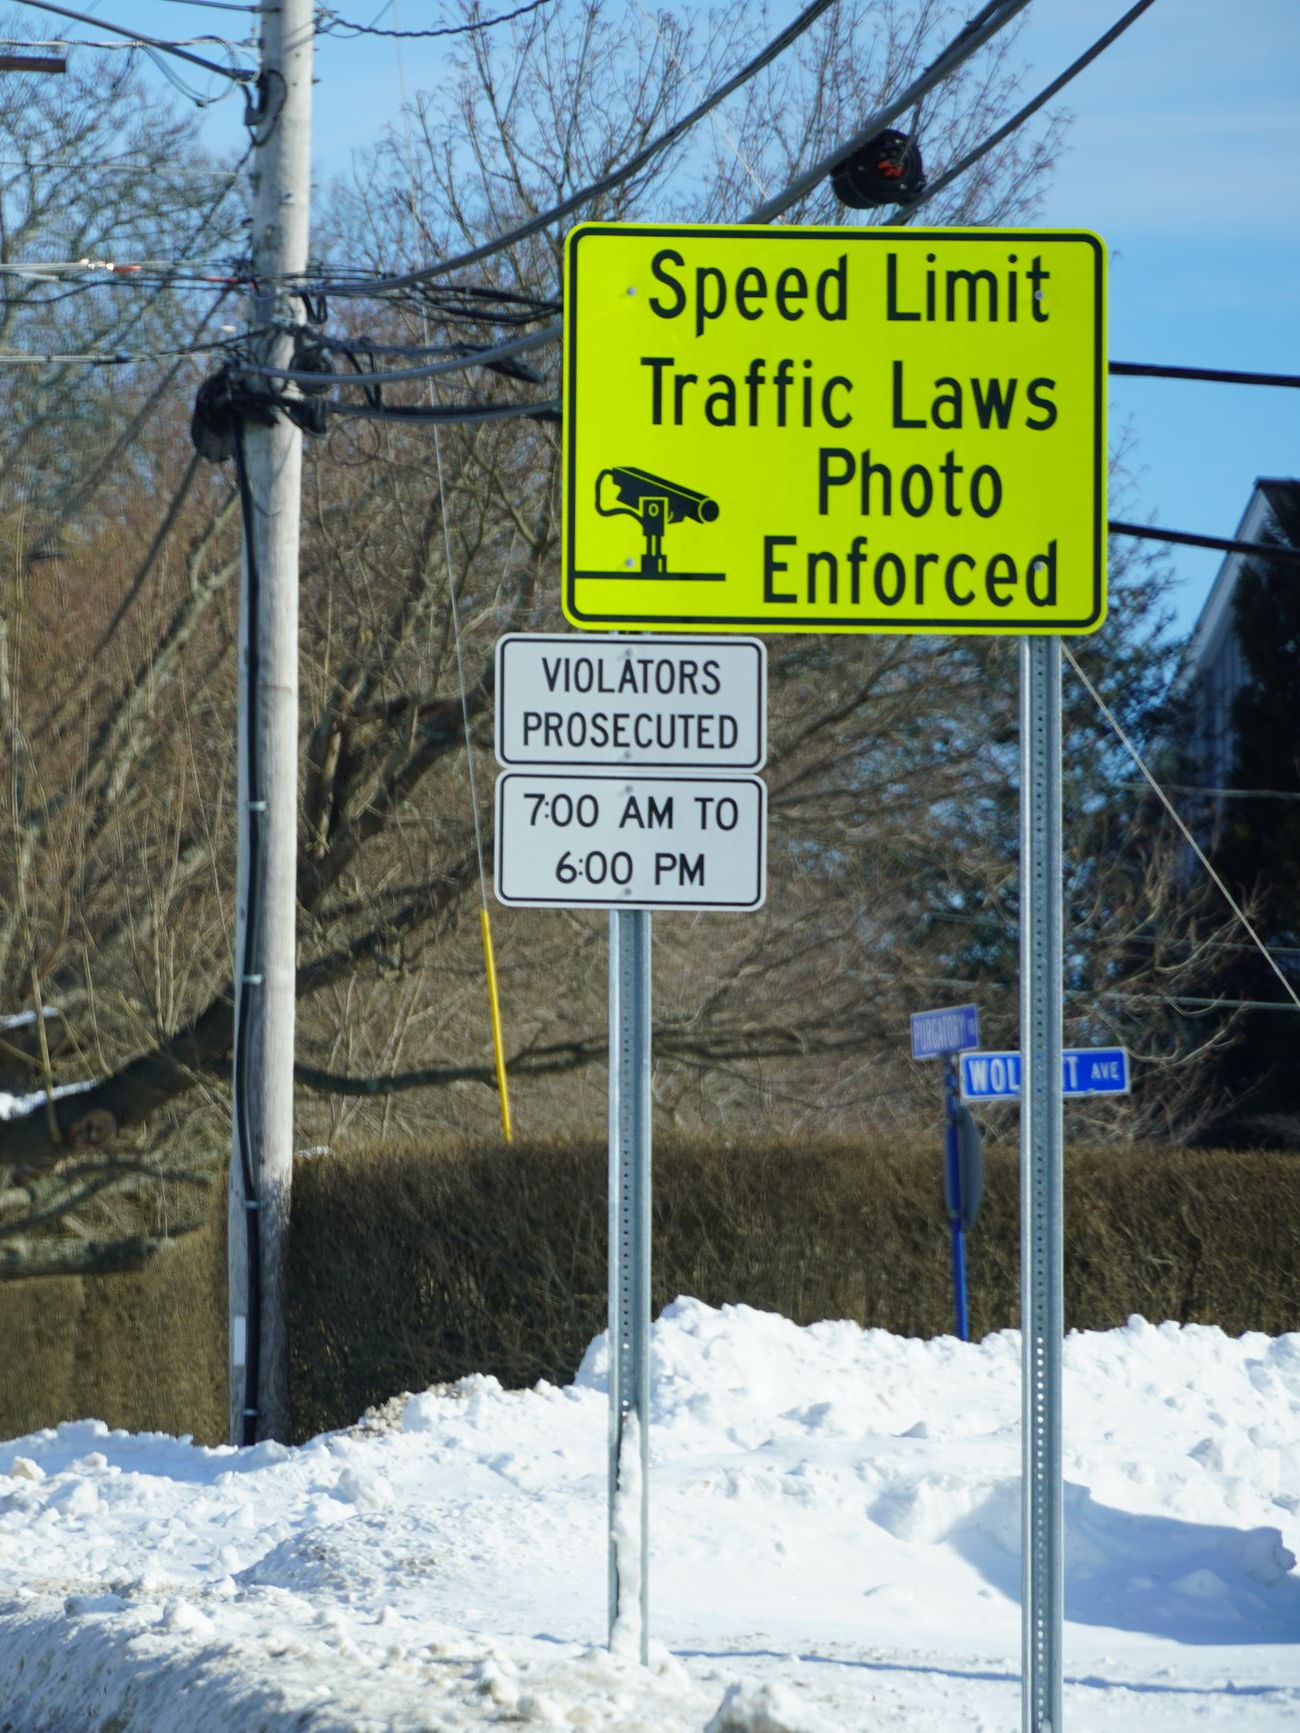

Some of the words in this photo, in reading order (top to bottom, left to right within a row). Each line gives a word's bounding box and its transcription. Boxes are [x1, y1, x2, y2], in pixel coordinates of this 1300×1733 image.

[649, 249, 848, 337] Speed
[887, 253, 1050, 323] Limit
[641, 357, 853, 429] Traffic
[893, 360, 1058, 431] Laws
[819, 447, 1002, 518] Photo
[763, 535, 1058, 606] Enforced
[541, 658, 721, 695] VIOLATORS
[523, 712, 738, 749] PROSECUTED
[523, 793, 599, 827] 7:00
[619, 796, 674, 829] AM
[694, 797, 738, 831] TO
[555, 851, 633, 885] 6:00
[655, 853, 705, 886] PM
[914, 1013, 964, 1052] PURGATORY
[968, 1056, 1078, 1093] WOLT
[1090, 1061, 1121, 1081] AVE
